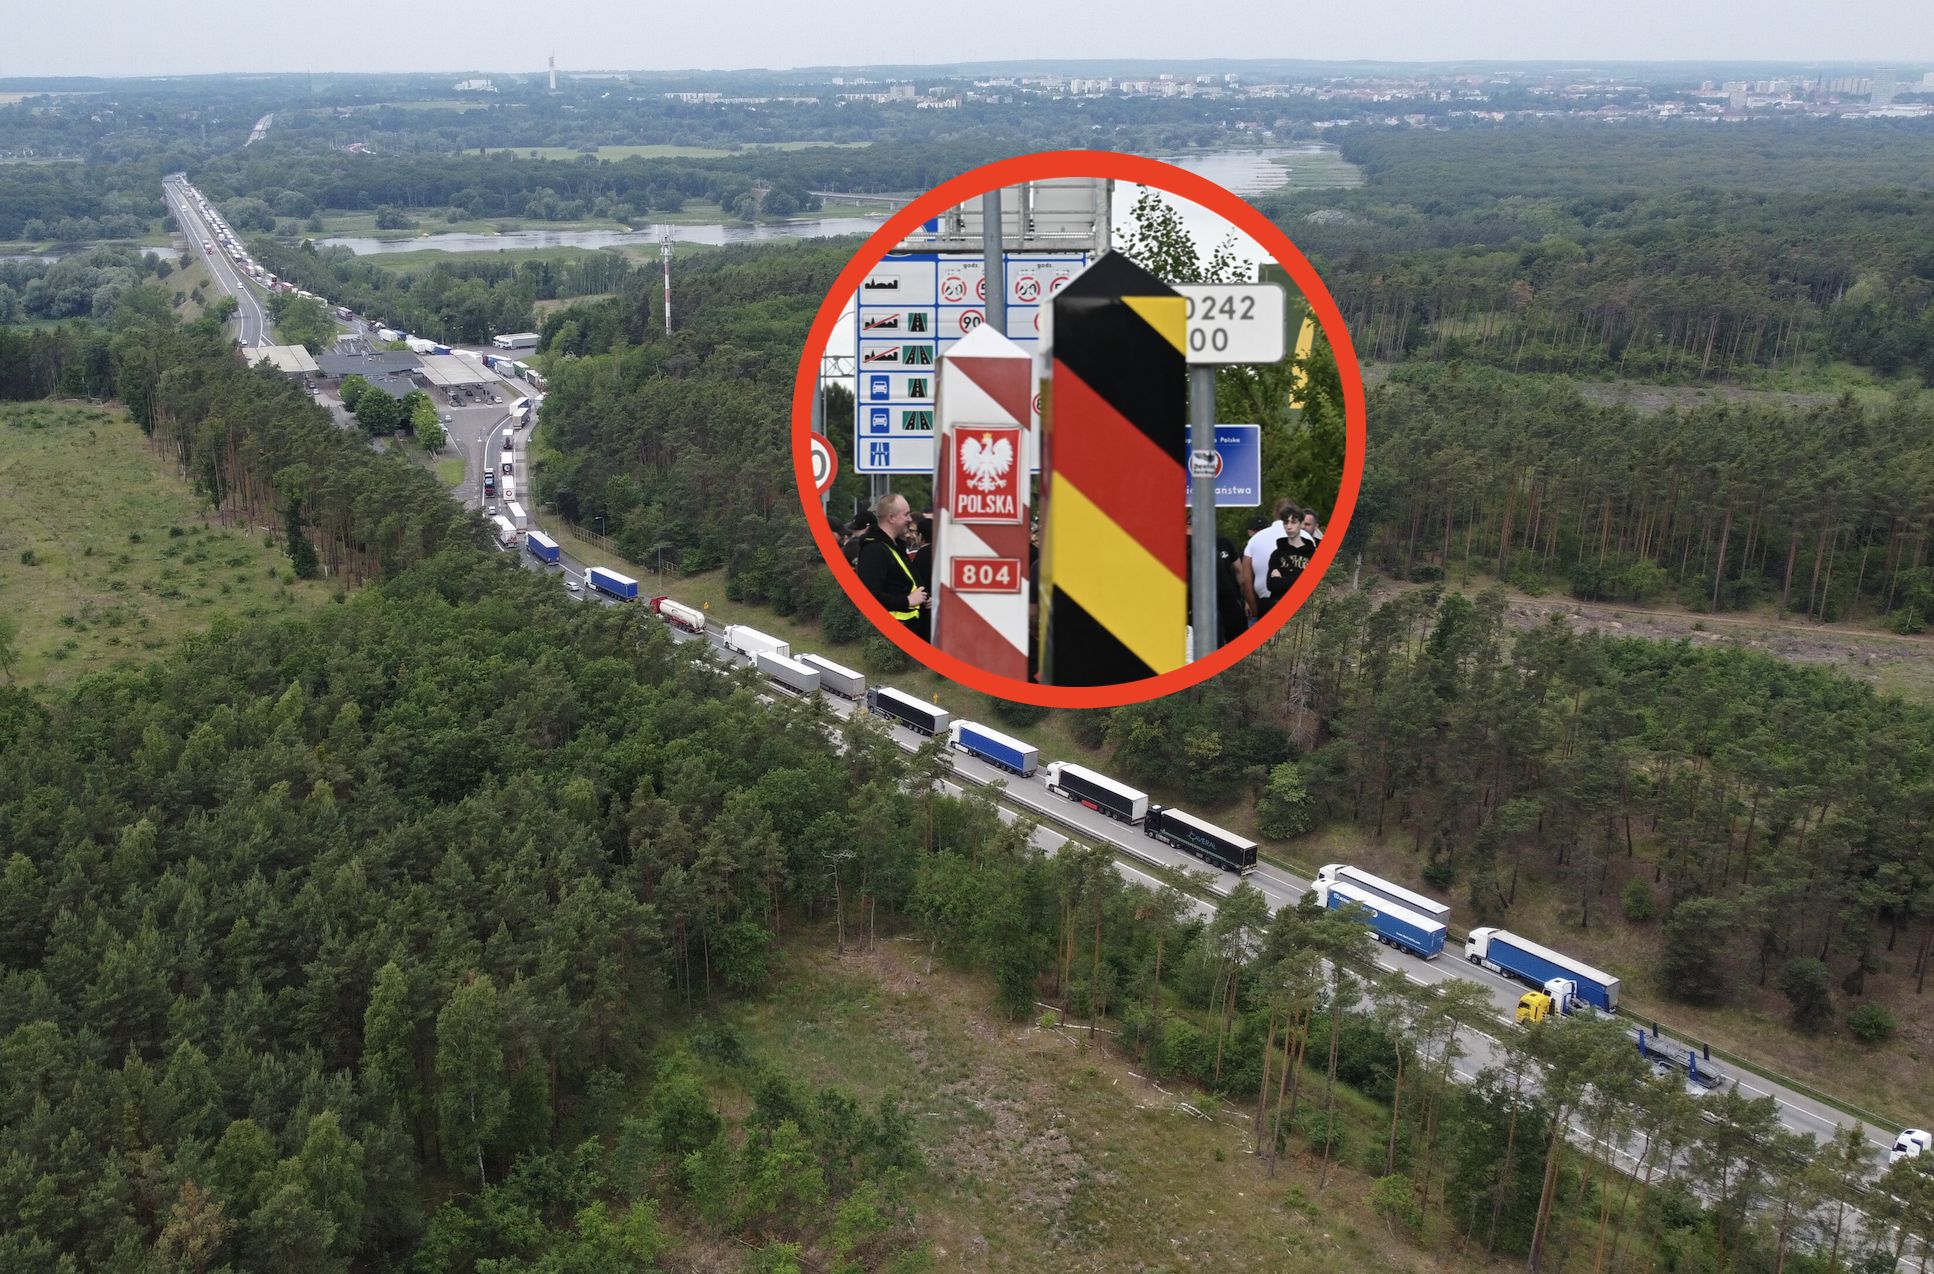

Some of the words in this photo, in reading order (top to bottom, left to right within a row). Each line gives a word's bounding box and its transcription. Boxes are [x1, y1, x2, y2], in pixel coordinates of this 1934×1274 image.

[963, 316, 981, 329] 90
[1220, 436, 1241, 444] Polska
[1214, 485, 1252, 495] aństwa
[957, 494, 1014, 514] POLSKA
[962, 565, 1011, 584] 804
